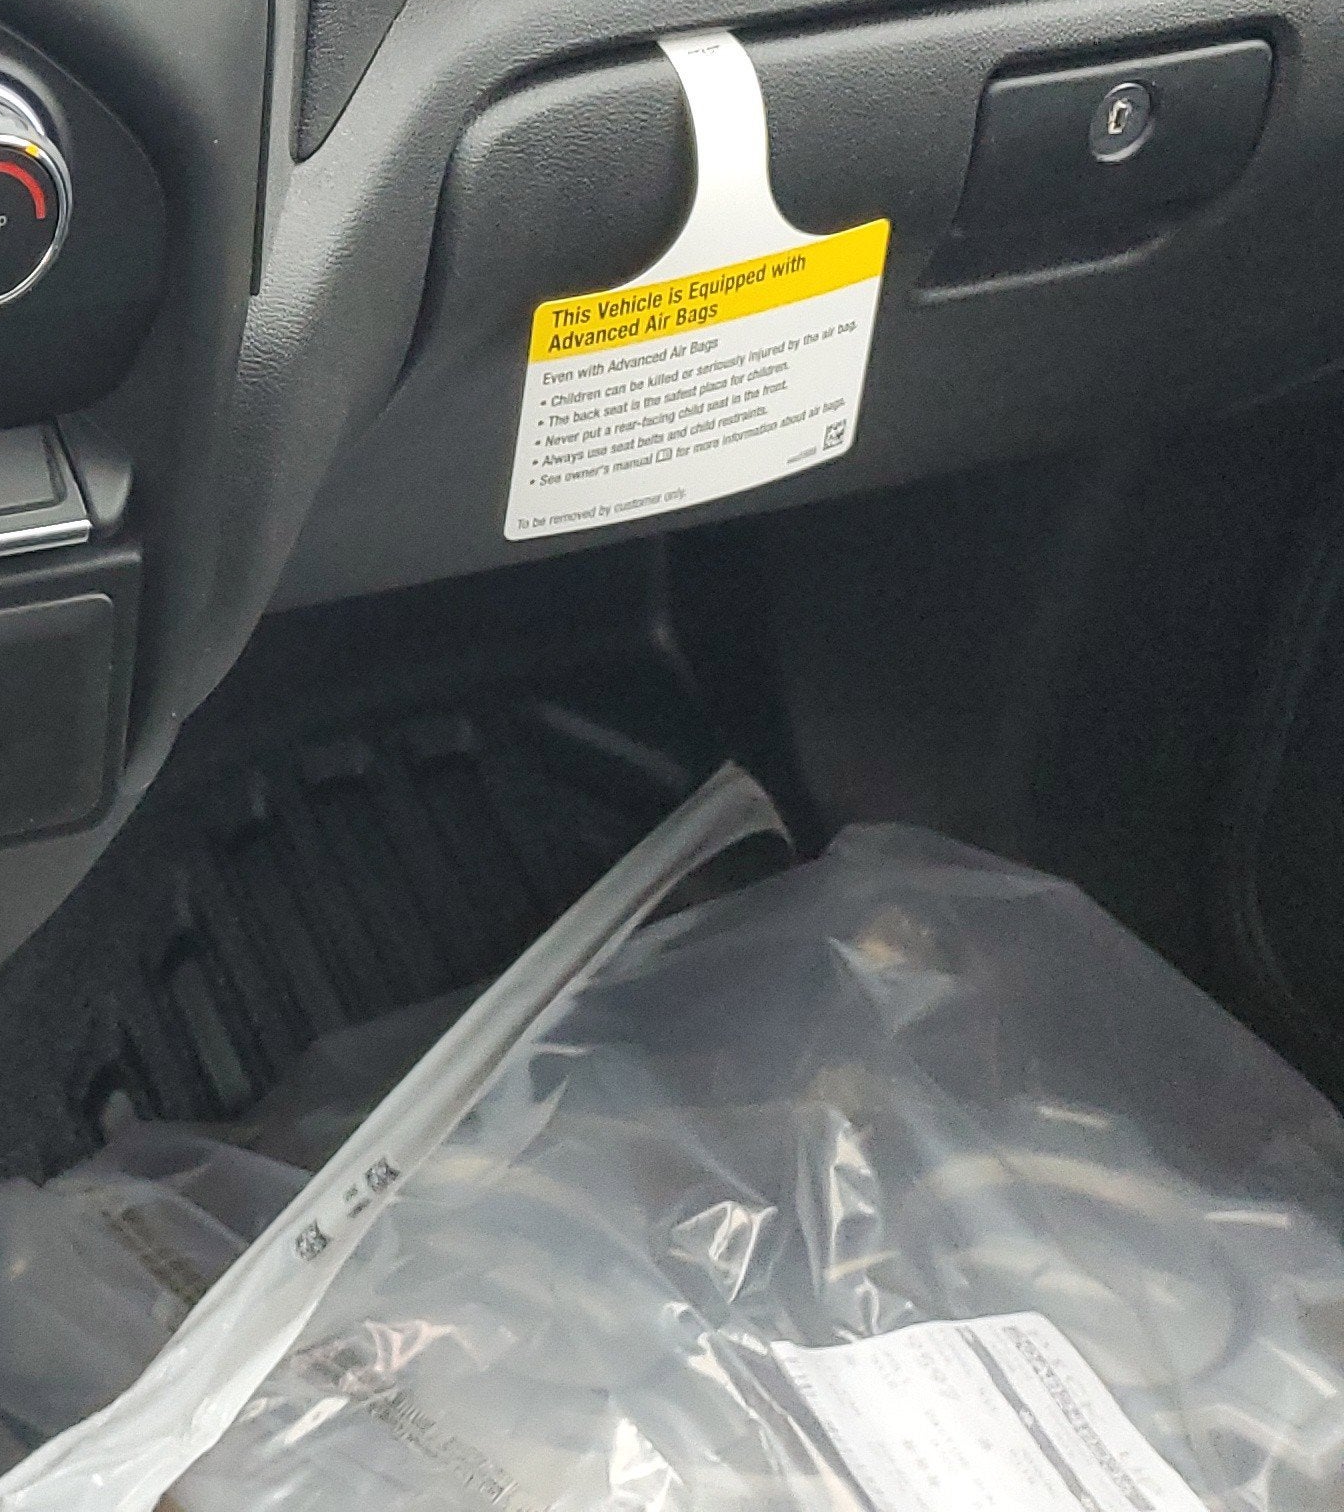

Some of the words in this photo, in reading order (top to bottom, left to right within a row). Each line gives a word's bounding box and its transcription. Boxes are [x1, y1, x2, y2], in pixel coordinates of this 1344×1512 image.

[551, 307, 591, 329] This
[598, 291, 663, 319] Vehicle
[667, 286, 683, 306] is
[688, 263, 767, 301] Equipped
[771, 253, 807, 279] with
[547, 320, 640, 353] Advanced
[644, 312, 671, 334] Air
[675, 303, 719, 328] Bags
[542, 370, 573, 386] Even
[577, 363, 605, 379] with
[607, 349, 668, 374] Advanced
[670, 344, 687, 359] Air
[689, 339, 719, 355] Bags
[550, 388, 602, 407] Children
[605, 383, 627, 396] can
[629, 378, 645, 391] be
[647, 372, 679, 388] killed
[681, 368, 694, 379] or
[787, 339, 801, 352] by
[803, 333, 820, 346] the
[545, 433, 580, 448] Never
[582, 428, 602, 444] put
[677, 403, 705, 420] child
[548, 415, 570, 428] The
[572, 407, 601, 423] back
[603, 402, 628, 417] seat
[541, 450, 585, 467] Always
[610, 439, 636, 455] seat
[539, 473, 562, 487] See
[517, 517, 530, 530] To
[531, 516, 547, 529] be
